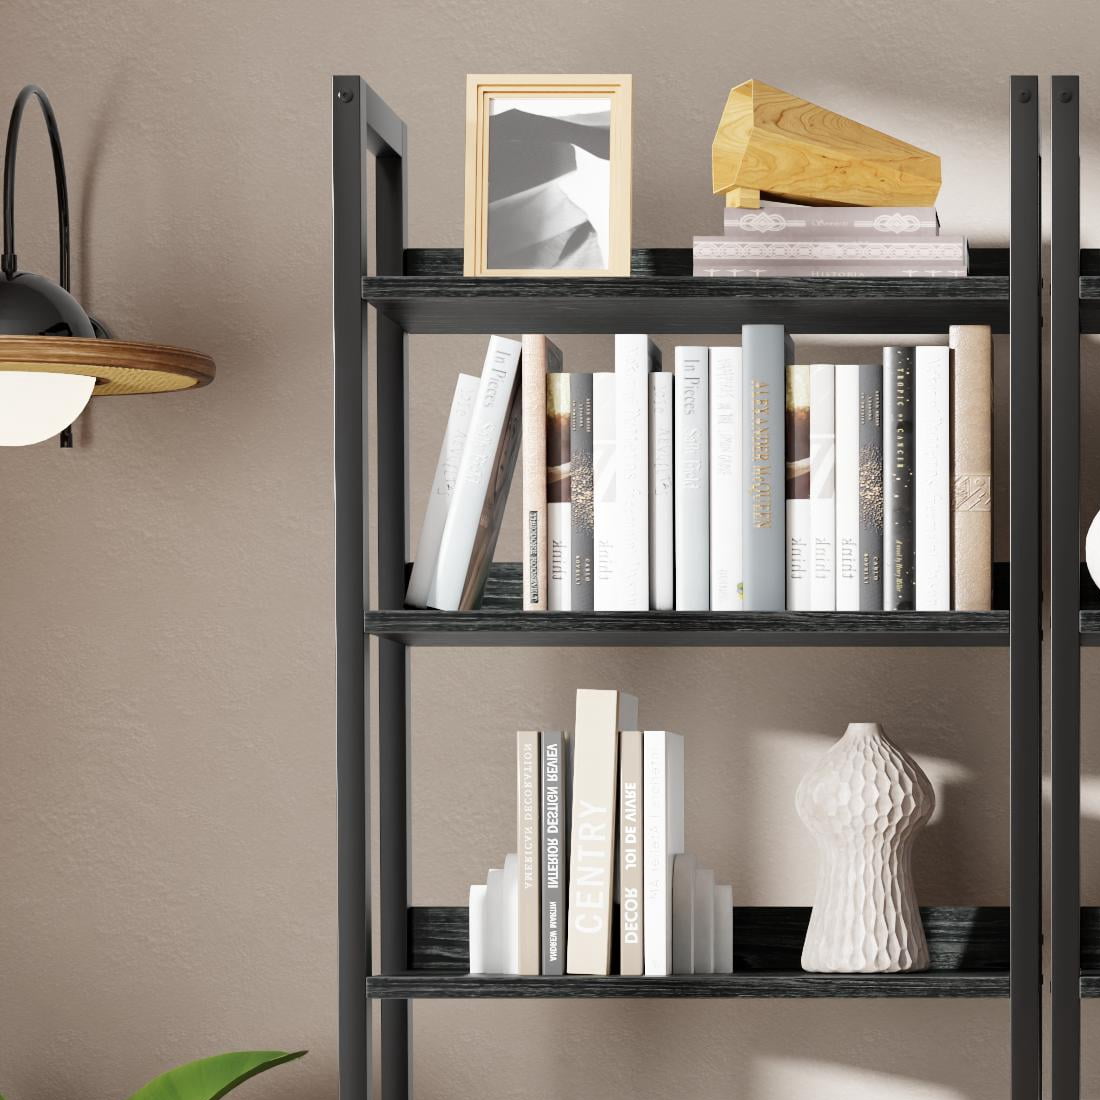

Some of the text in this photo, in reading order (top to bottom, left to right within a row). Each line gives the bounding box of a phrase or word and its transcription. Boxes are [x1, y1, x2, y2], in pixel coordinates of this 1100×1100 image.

[483, 349, 511, 409] In Pieces
[683, 359, 702, 416] In Pieces
[896, 368, 904, 406] TROPIC
[752, 380, 771, 462] ALEXANDER
[896, 428, 904, 468] CANCER
[574, 799, 607, 935] CENTRY
